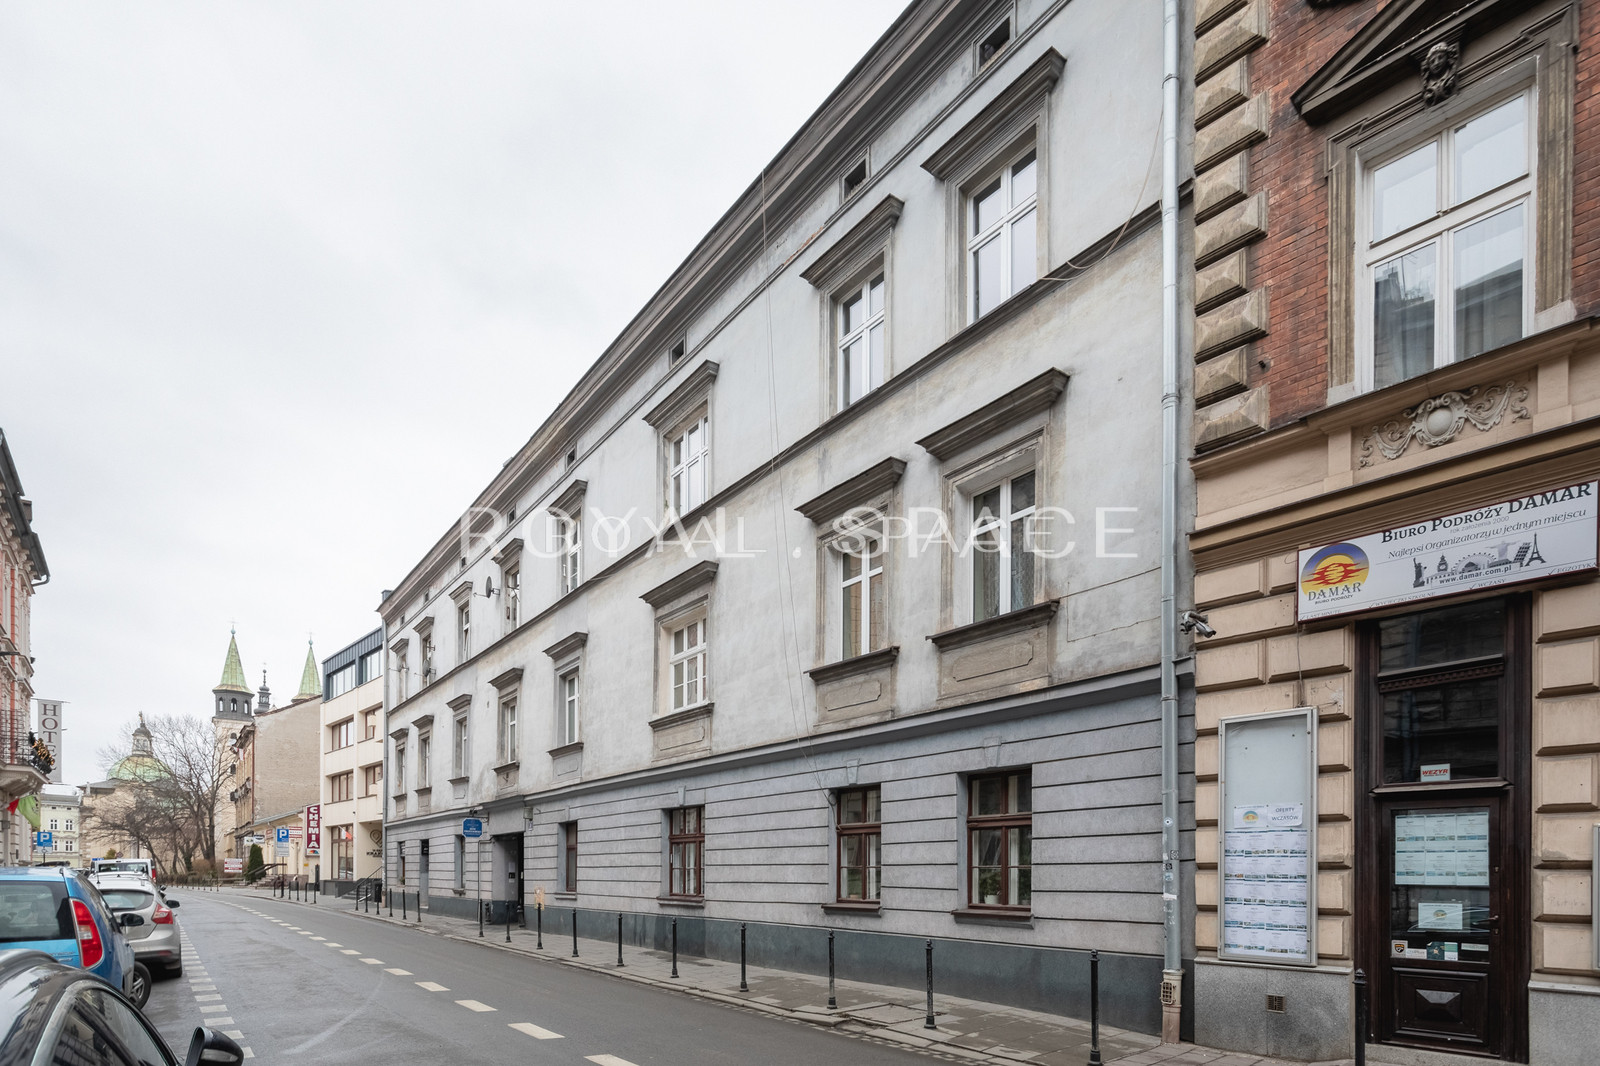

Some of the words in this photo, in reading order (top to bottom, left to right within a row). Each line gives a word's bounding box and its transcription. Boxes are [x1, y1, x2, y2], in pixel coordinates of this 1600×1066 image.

[1381, 525, 1427, 543] BIURO
[1431, 506, 1504, 532] PODRÓŻY
[1508, 483, 1592, 514] DAMAR
[1493, 516, 1509, 525] 2000
[1388, 544, 1424, 559] Najlepsi
[1425, 529, 1491, 551] Organizatorzy
[1492, 529, 1502, 537] w
[1502, 518, 1542, 536] jednym
[1544, 508, 1587, 523] miejscu
[1439, 565, 1513, 585] www.damar.com.pl
[1308, 582, 1362, 601] DAMAR
[42, 704, 58, 771] HOTE
[40, 832, 50, 843] P
[280, 829, 287, 838] P
[308, 807, 319, 848] CHEMIA
